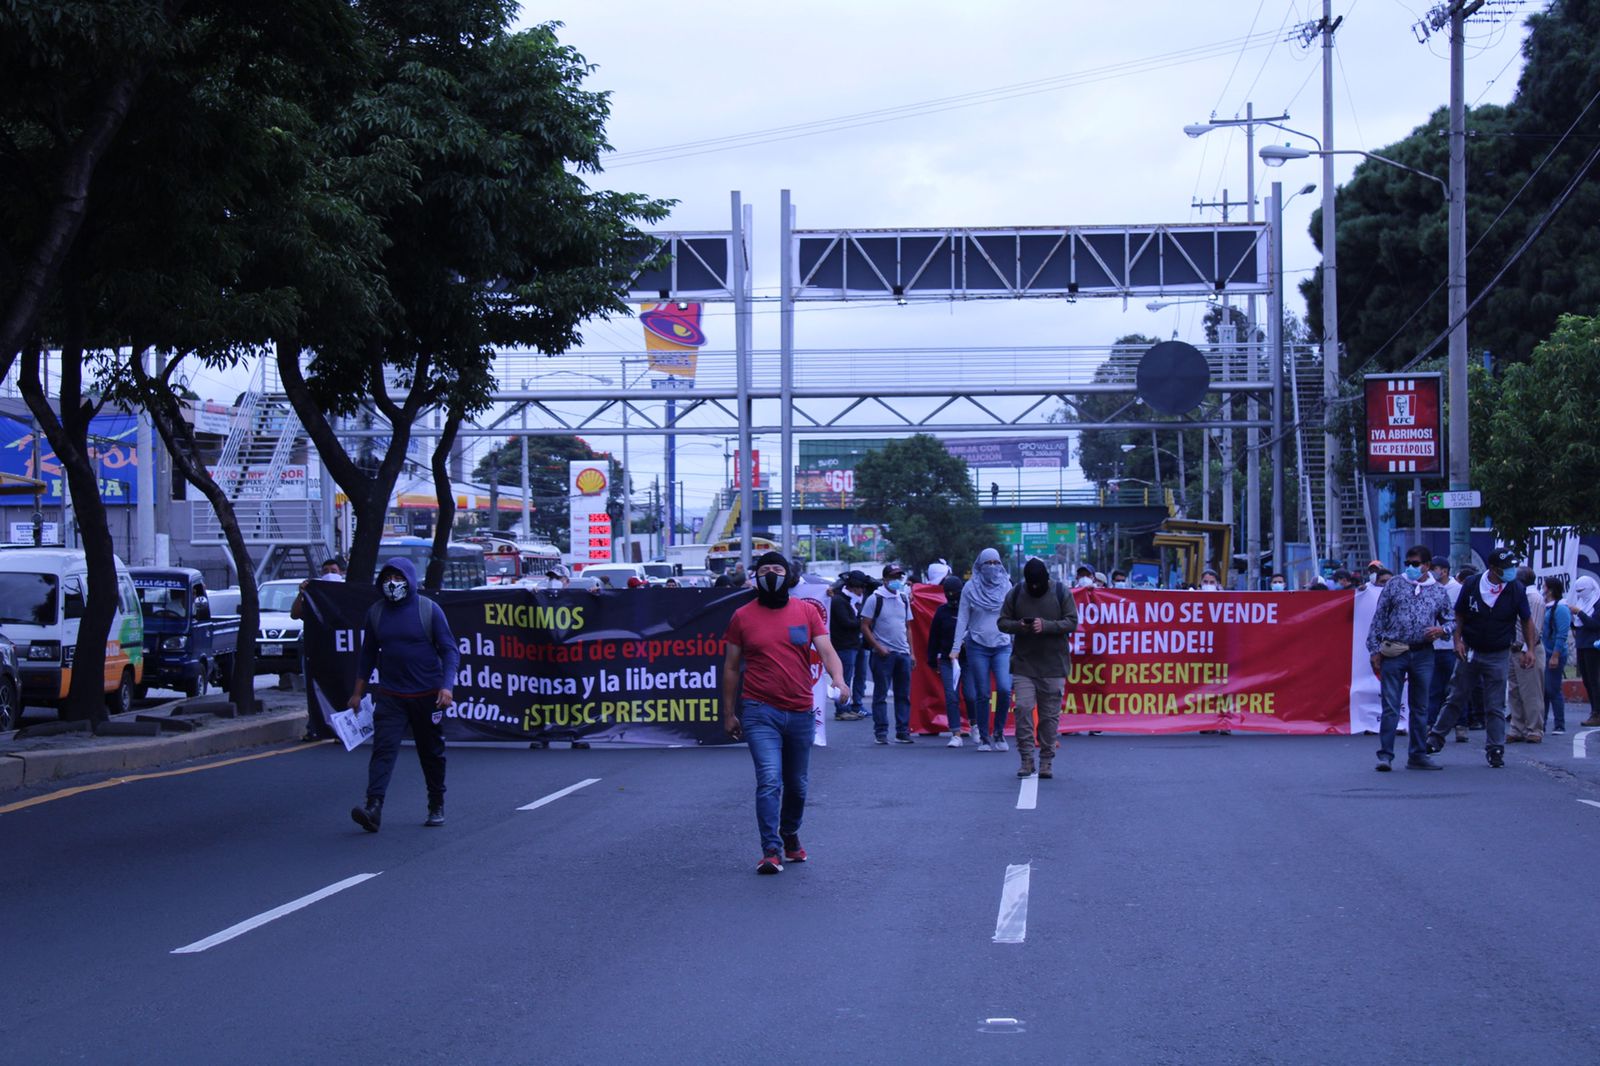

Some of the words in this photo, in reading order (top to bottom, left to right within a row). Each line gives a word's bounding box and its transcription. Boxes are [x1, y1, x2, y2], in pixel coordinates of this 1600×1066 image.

[1371, 430, 1386, 440] ¡YA
[1388, 429, 1432, 439] ABRIMOS!
[1373, 445, 1388, 453] KFC
[1145, 601, 1175, 623] NO
[1179, 602, 1203, 623] SE
[1208, 602, 1278, 624] VENDE
[1469, 596, 1479, 612] LA
[484, 603, 584, 630] EXIGIMOS
[335, 629, 354, 652] El
[459, 636, 471, 655] a
[476, 633, 495, 657] la
[500, 634, 583, 663] libertad
[589, 640, 616, 661] de
[1092, 630, 1214, 655] DEFIENDE!!
[477, 665, 502, 689] de
[507, 673, 577, 697] prensa
[582, 676, 595, 699] y
[600, 669, 620, 692] la
[625, 665, 717, 691] libertad
[1067, 663, 1106, 684] USC
[1111, 662, 1229, 685] PRESENTE!!
[523, 702, 596, 731] ¡STUSC
[602, 699, 718, 723] PRESENTE!
[1062, 692, 1078, 714] A
[1082, 692, 1179, 715] VICTORIA
[1183, 692, 1275, 714] SIEMPRE
